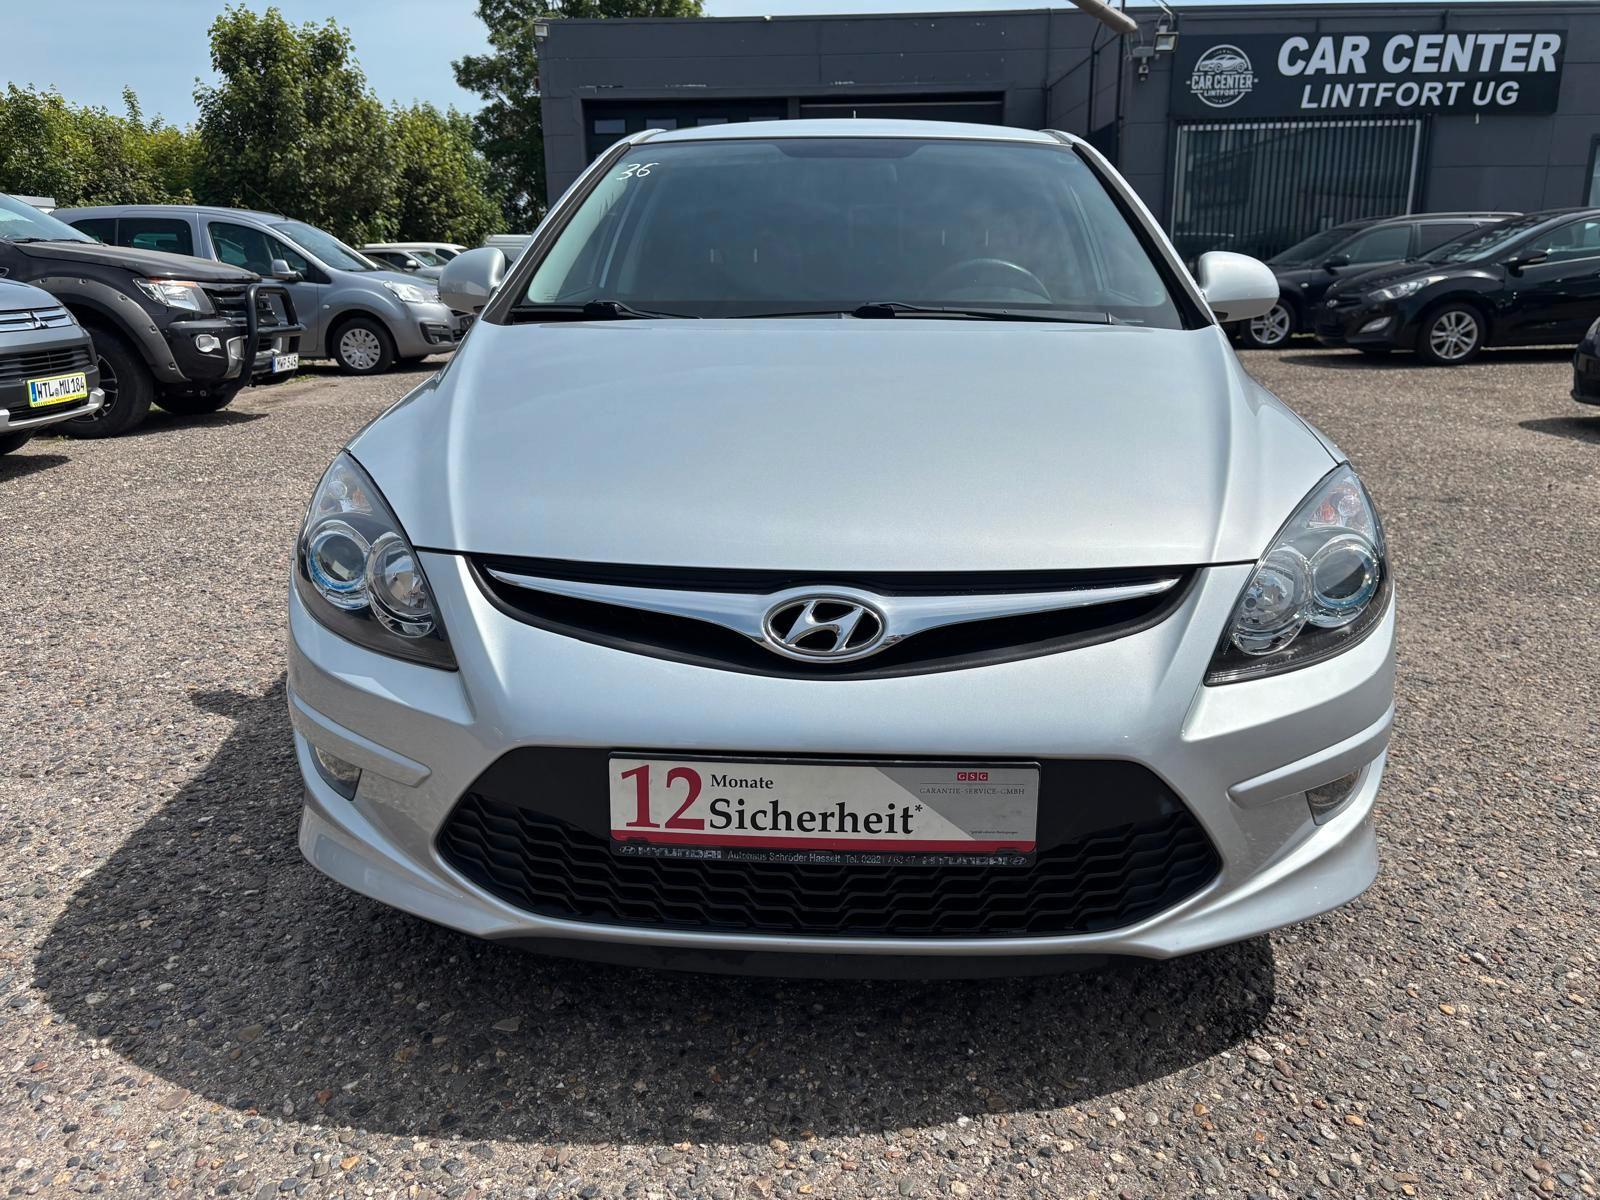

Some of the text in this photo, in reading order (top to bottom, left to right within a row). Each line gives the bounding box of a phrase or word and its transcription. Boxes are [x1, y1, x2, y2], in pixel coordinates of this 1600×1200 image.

[1277, 33, 1561, 76] CAR CENTER
[1192, 74, 1253, 89] CAR CENTER
[1300, 81, 1520, 109] LINTFORT UG
[616, 162, 660, 180] 36
[957, 772, 988, 781] GSG
[621, 764, 774, 831] 12 Monate
[769, 852, 807, 862] Schröder
